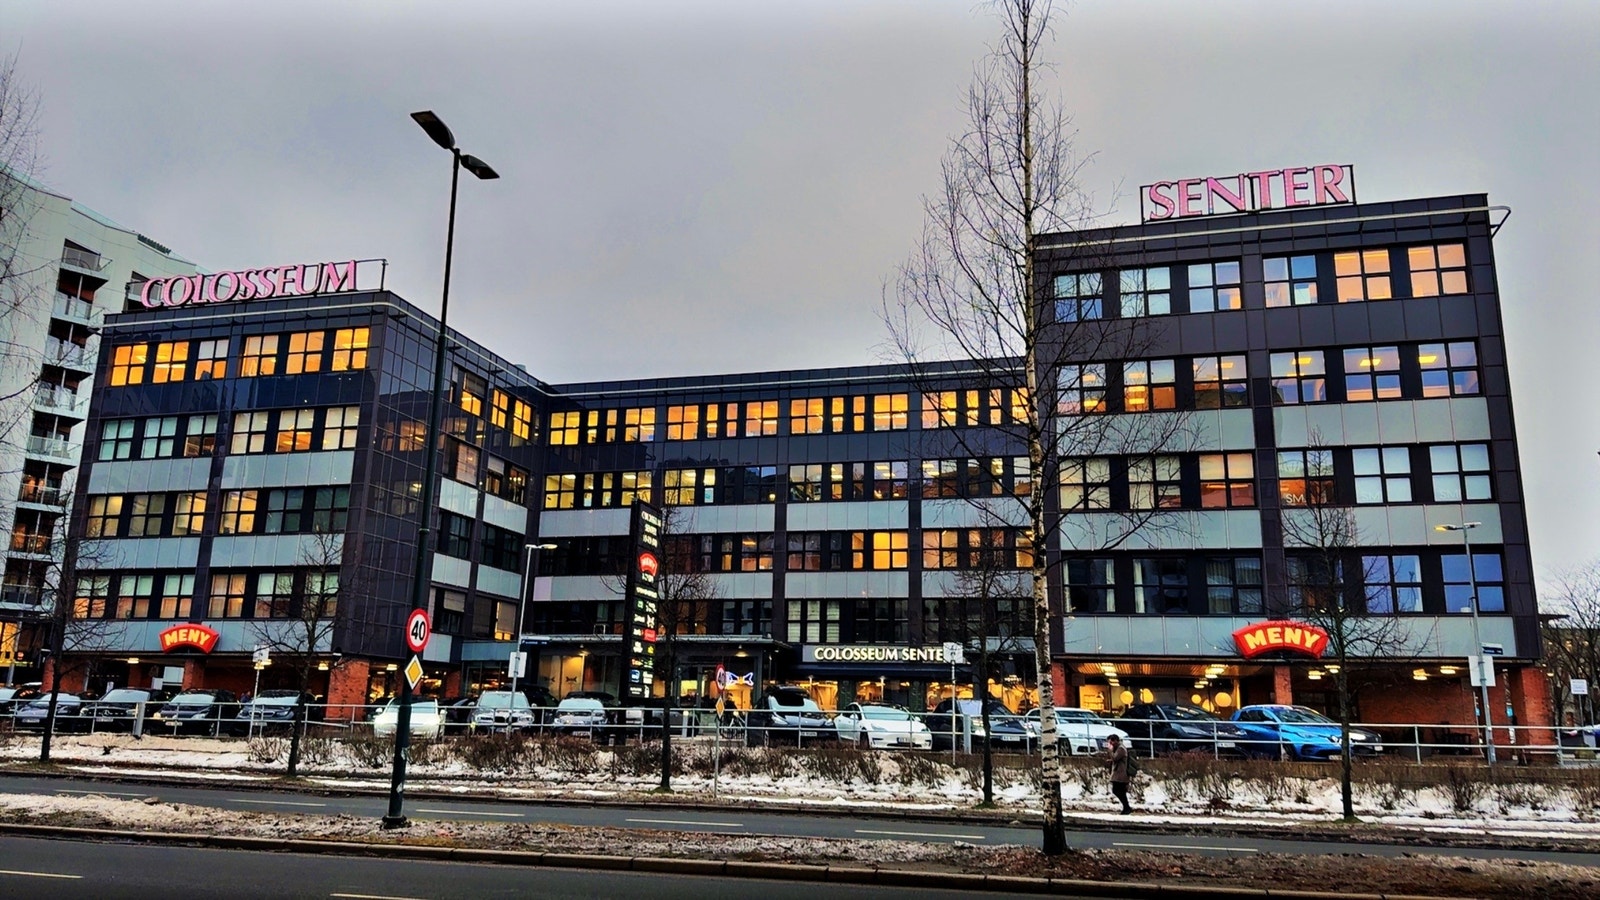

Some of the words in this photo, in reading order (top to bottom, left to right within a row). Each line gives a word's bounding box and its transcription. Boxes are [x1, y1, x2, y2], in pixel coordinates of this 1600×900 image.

[1149, 164, 1349, 220] SENTER
[141, 259, 357, 309] COLOSSEUM
[164, 629, 211, 647] MENY
[411, 620, 426, 641] 40
[1243, 627, 1321, 650] MENY
[814, 647, 899, 661] COLOSSEUM
[902, 647, 943, 661] SENTE
